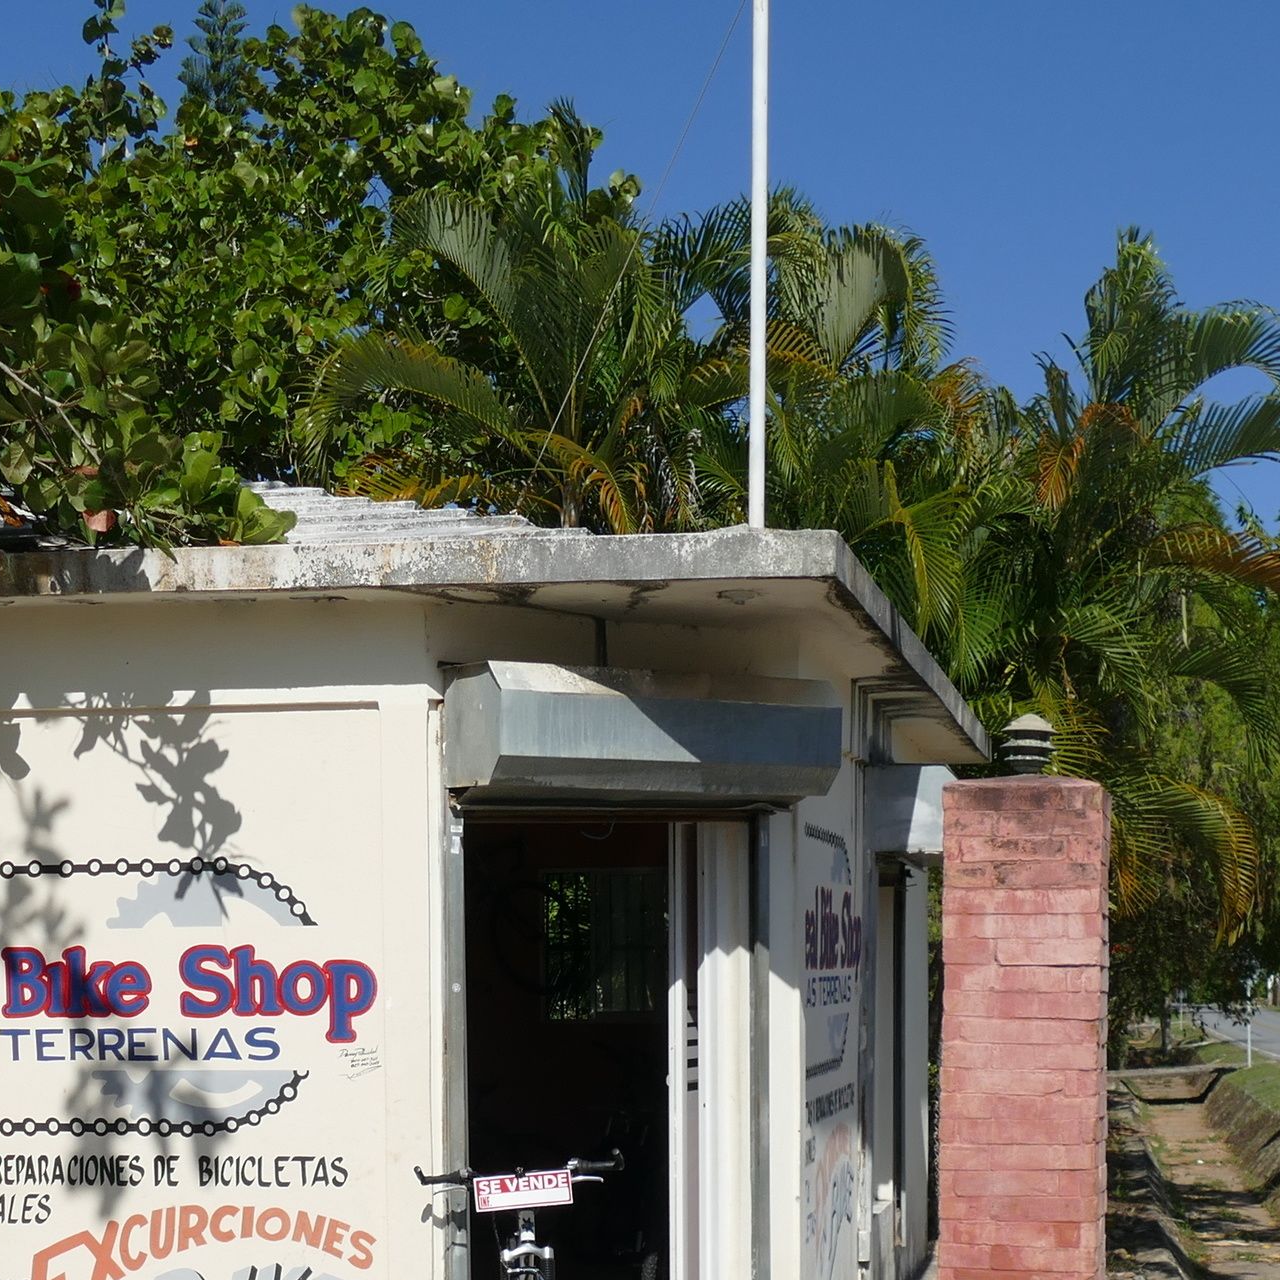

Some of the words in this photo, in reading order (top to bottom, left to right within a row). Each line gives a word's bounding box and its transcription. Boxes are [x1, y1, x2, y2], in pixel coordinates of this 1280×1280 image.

[805, 885, 818, 970] eal
[841, 891, 861, 983] Shop
[1, 945, 152, 1020] Bike
[179, 943, 378, 1044] Shop
[805, 977, 816, 1007] AS
[0, 1027, 282, 1063] TERRENAS
[153, 1155, 181, 1187] DE
[198, 1155, 350, 1188] BICICLETAS
[479, 1180, 502, 1195] SE
[504, 1173, 568, 1192] VENDE
